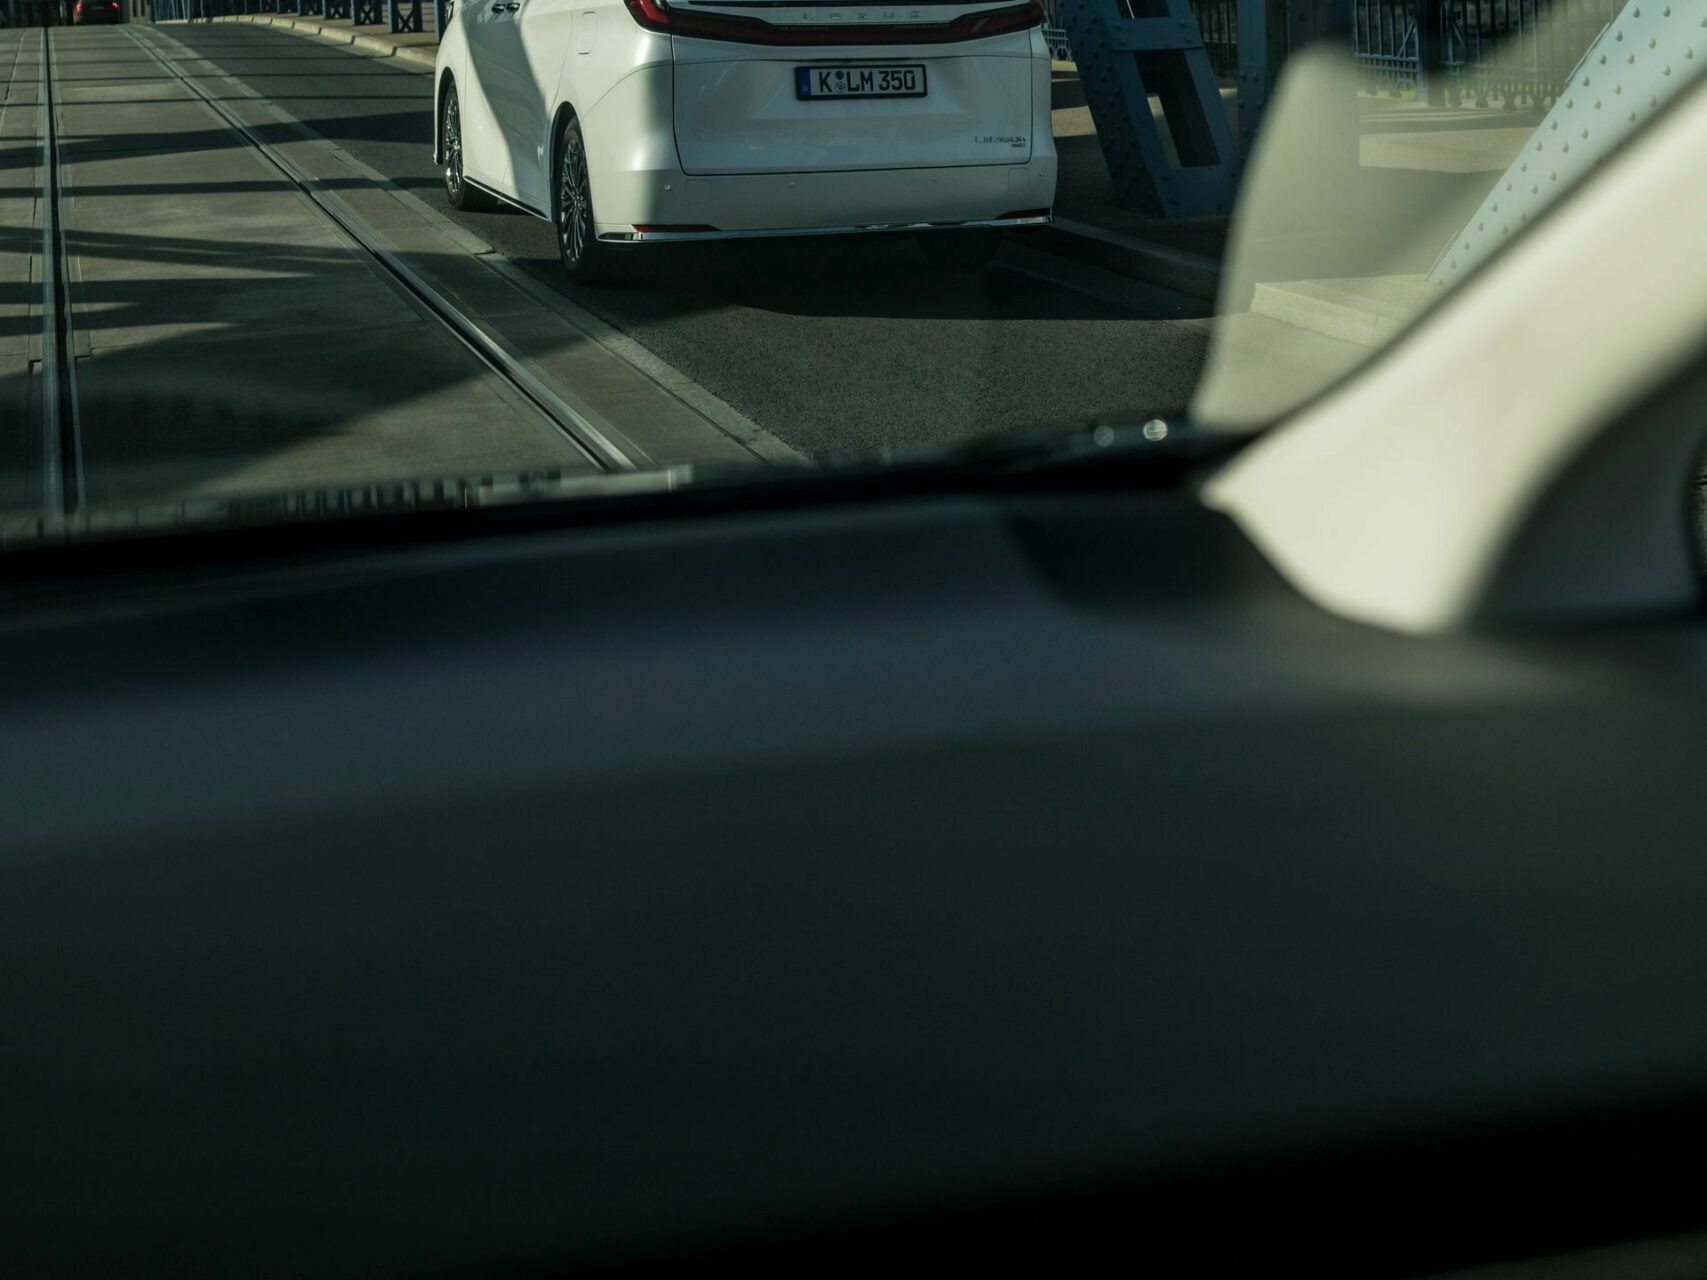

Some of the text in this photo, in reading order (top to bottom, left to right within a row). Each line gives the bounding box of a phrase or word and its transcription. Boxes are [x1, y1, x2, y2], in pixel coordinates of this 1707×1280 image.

[818, 71, 832, 93] K
[846, 70, 874, 92] LM
[878, 70, 916, 91] 350
